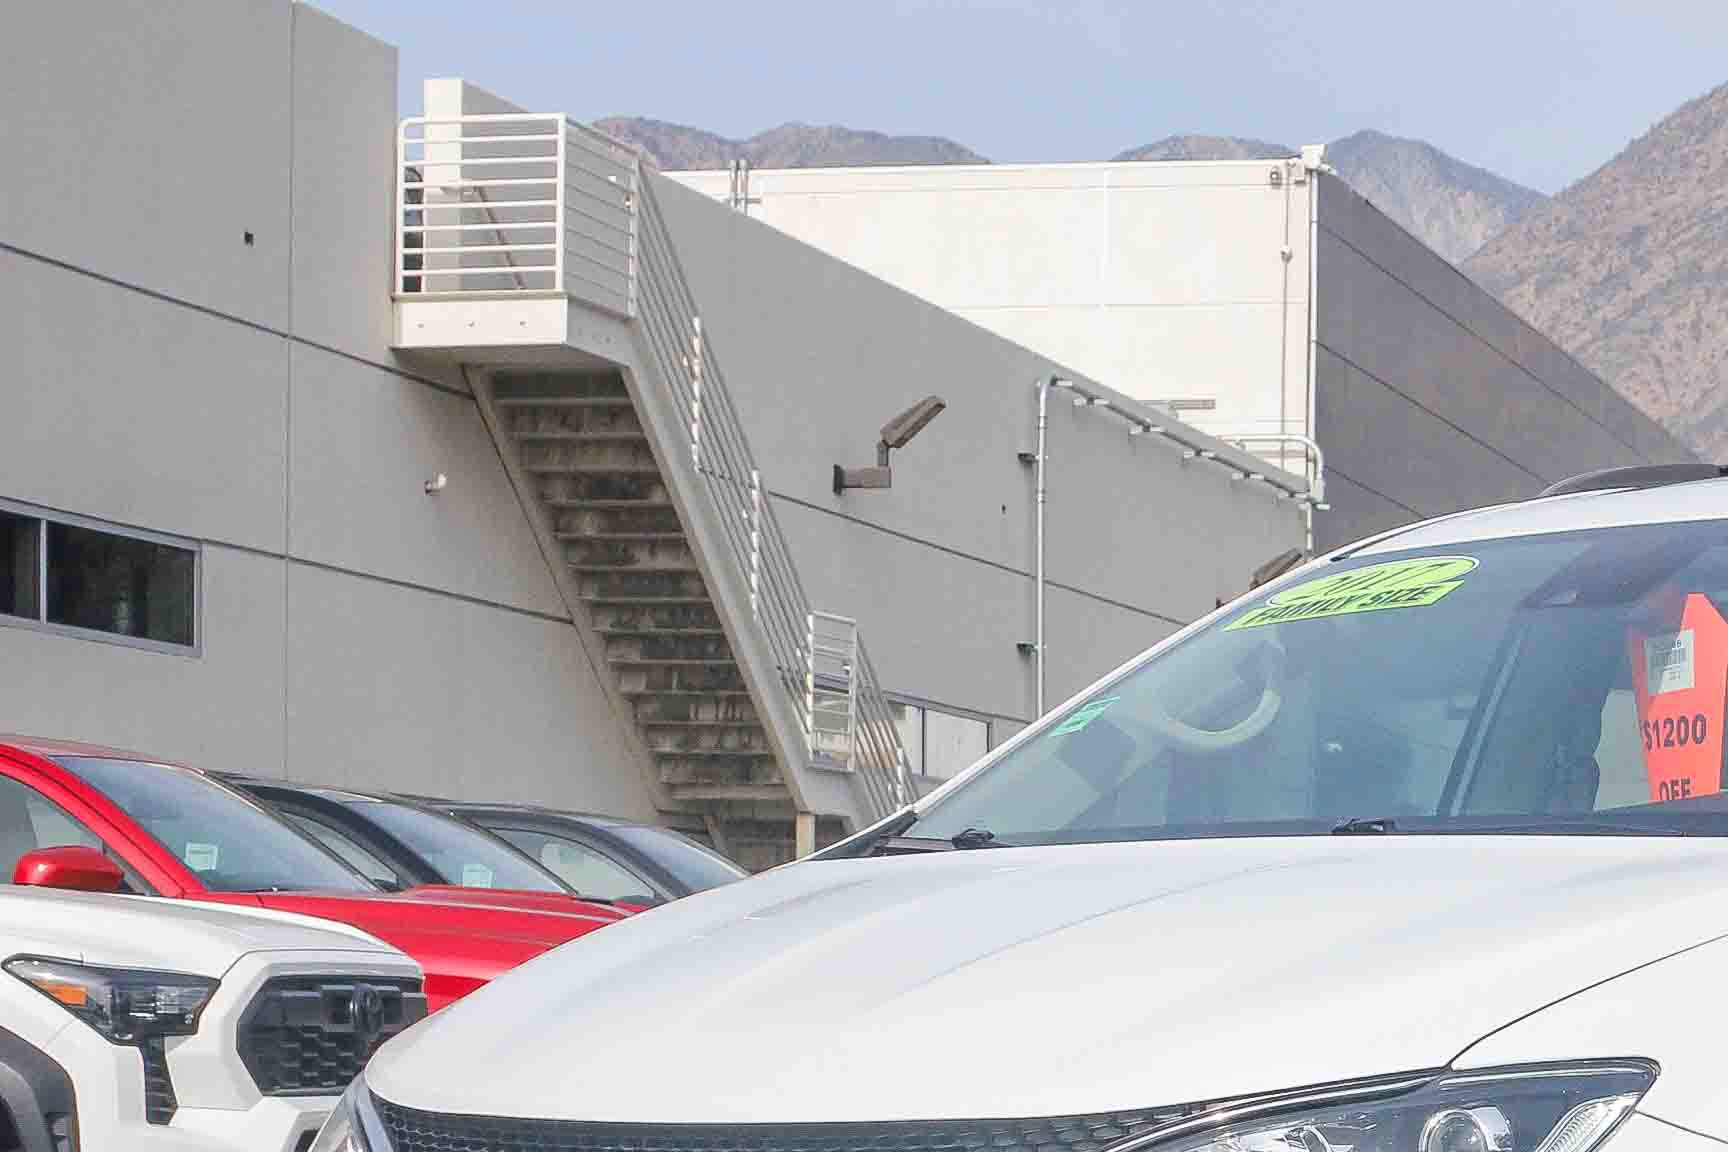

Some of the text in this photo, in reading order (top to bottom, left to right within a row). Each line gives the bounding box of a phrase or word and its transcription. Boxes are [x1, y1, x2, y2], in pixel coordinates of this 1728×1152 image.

[1241, 585, 1441, 625] FAMILY SIZE
[1659, 777, 1691, 801] OFF
